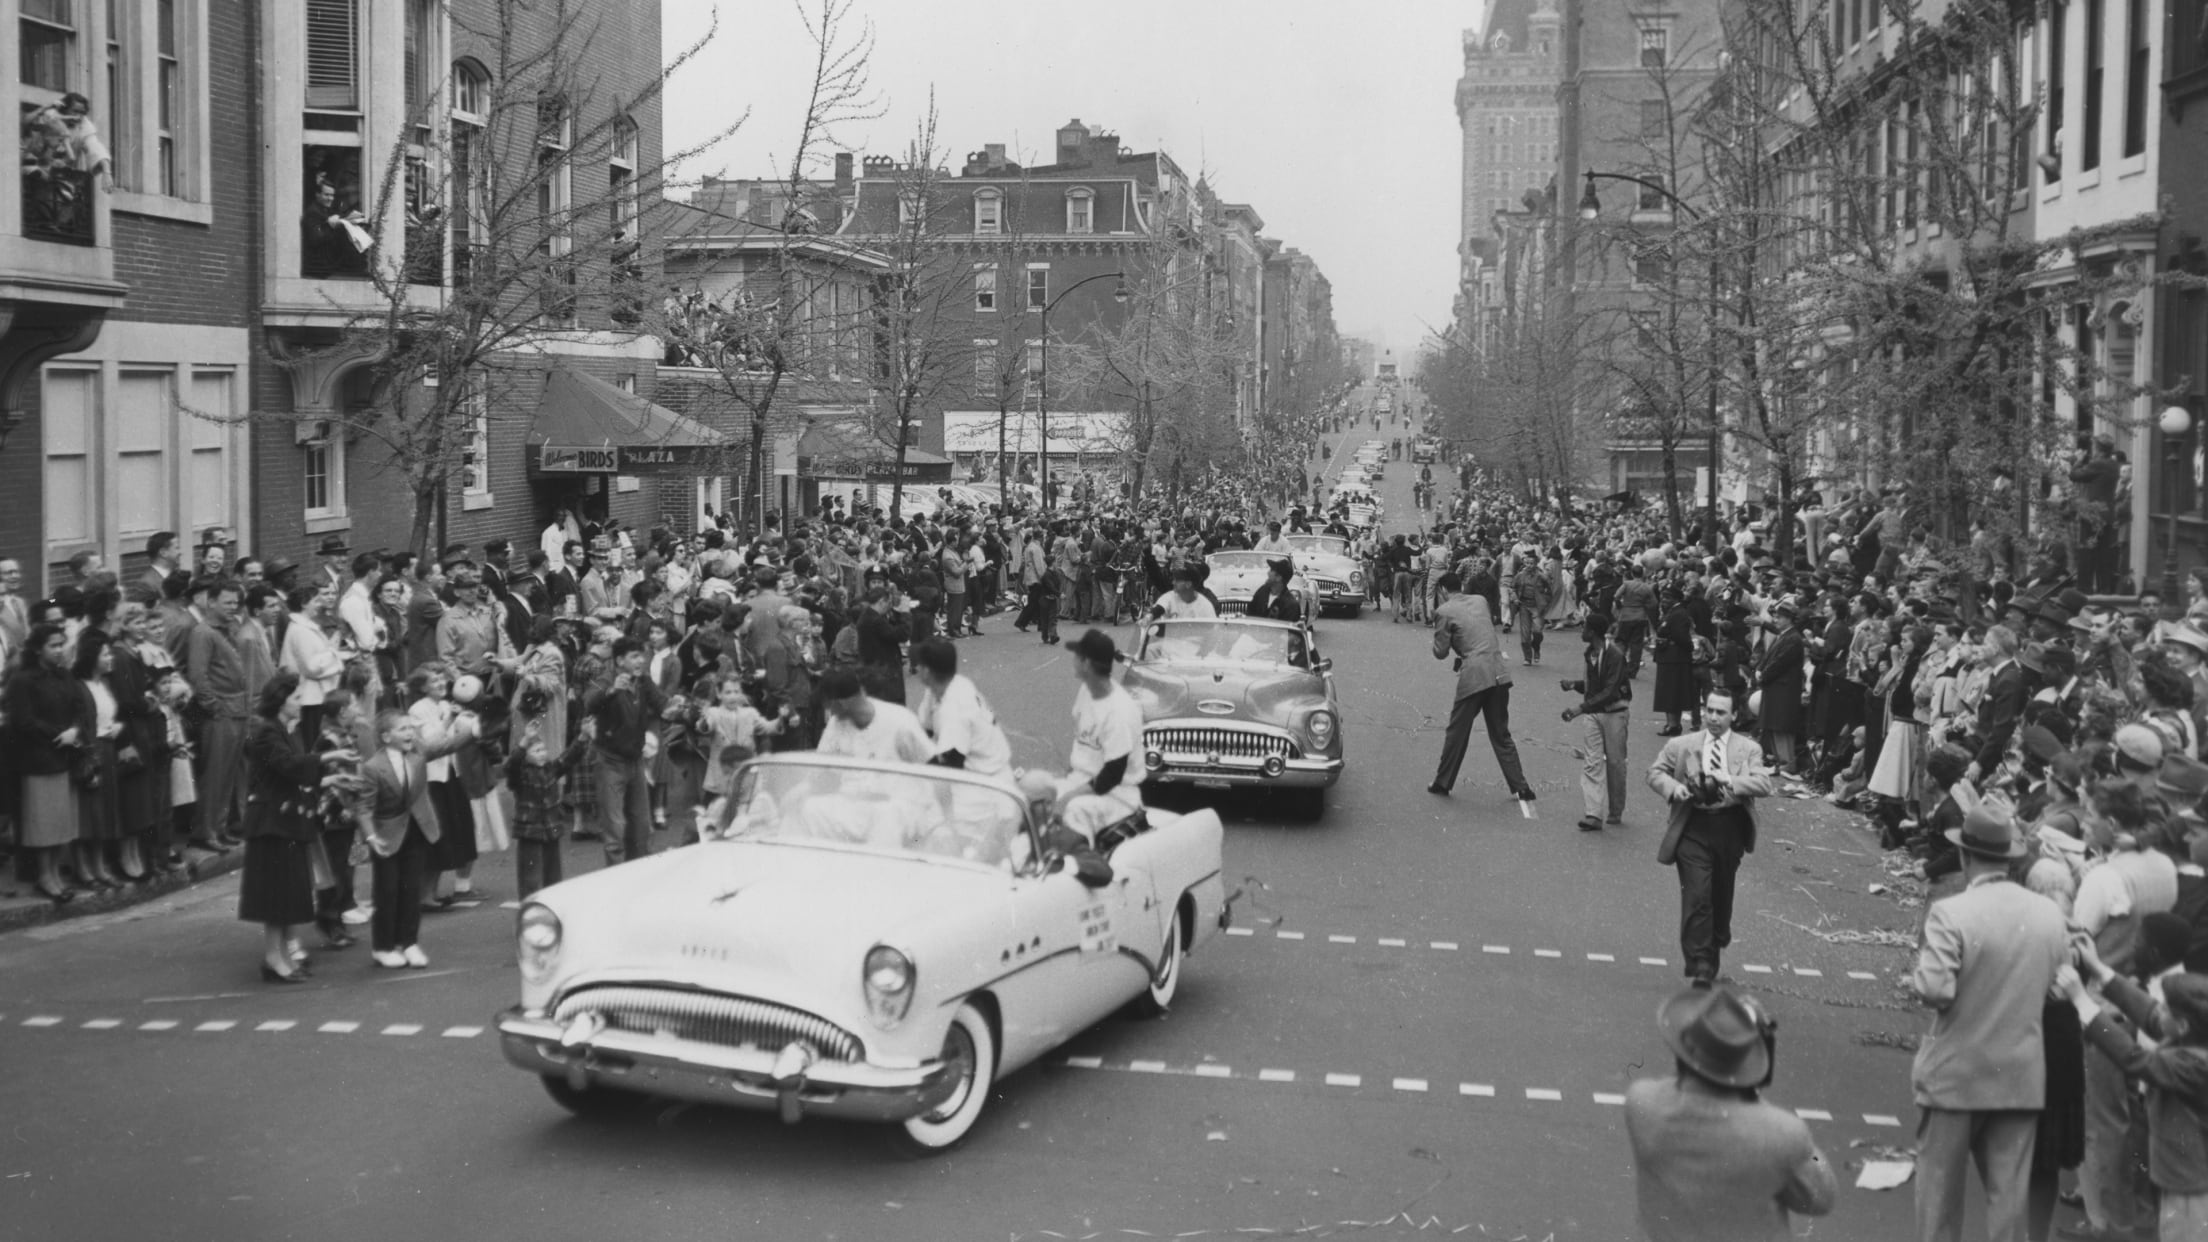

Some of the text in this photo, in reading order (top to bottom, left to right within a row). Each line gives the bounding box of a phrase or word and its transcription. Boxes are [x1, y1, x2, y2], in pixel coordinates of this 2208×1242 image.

[578, 450, 614, 468] BIRDS
[629, 450, 674, 463] PLAZA
[903, 466, 919, 476] BAR
